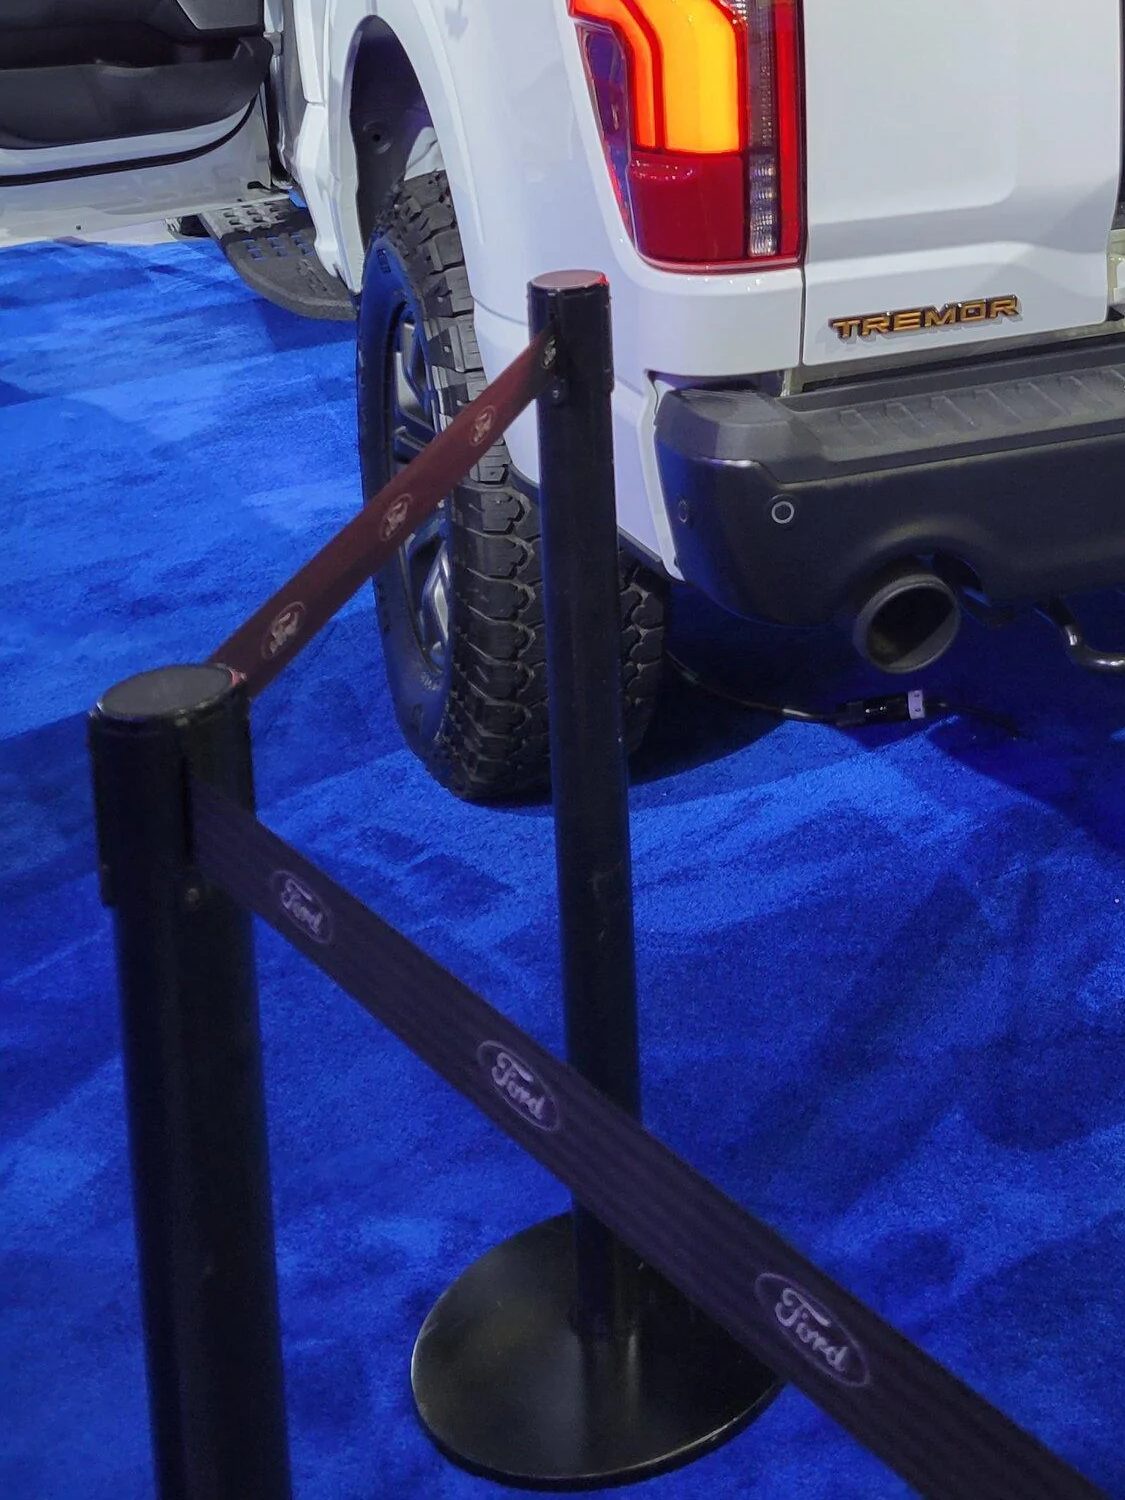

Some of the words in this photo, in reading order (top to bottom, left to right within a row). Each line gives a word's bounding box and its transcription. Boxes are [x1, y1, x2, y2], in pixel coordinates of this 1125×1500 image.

[829, 295, 1020, 338] TREMOR
[281, 879, 324, 934] Ford
[491, 1052, 545, 1120] Ford
[775, 1288, 849, 1372] Ford
